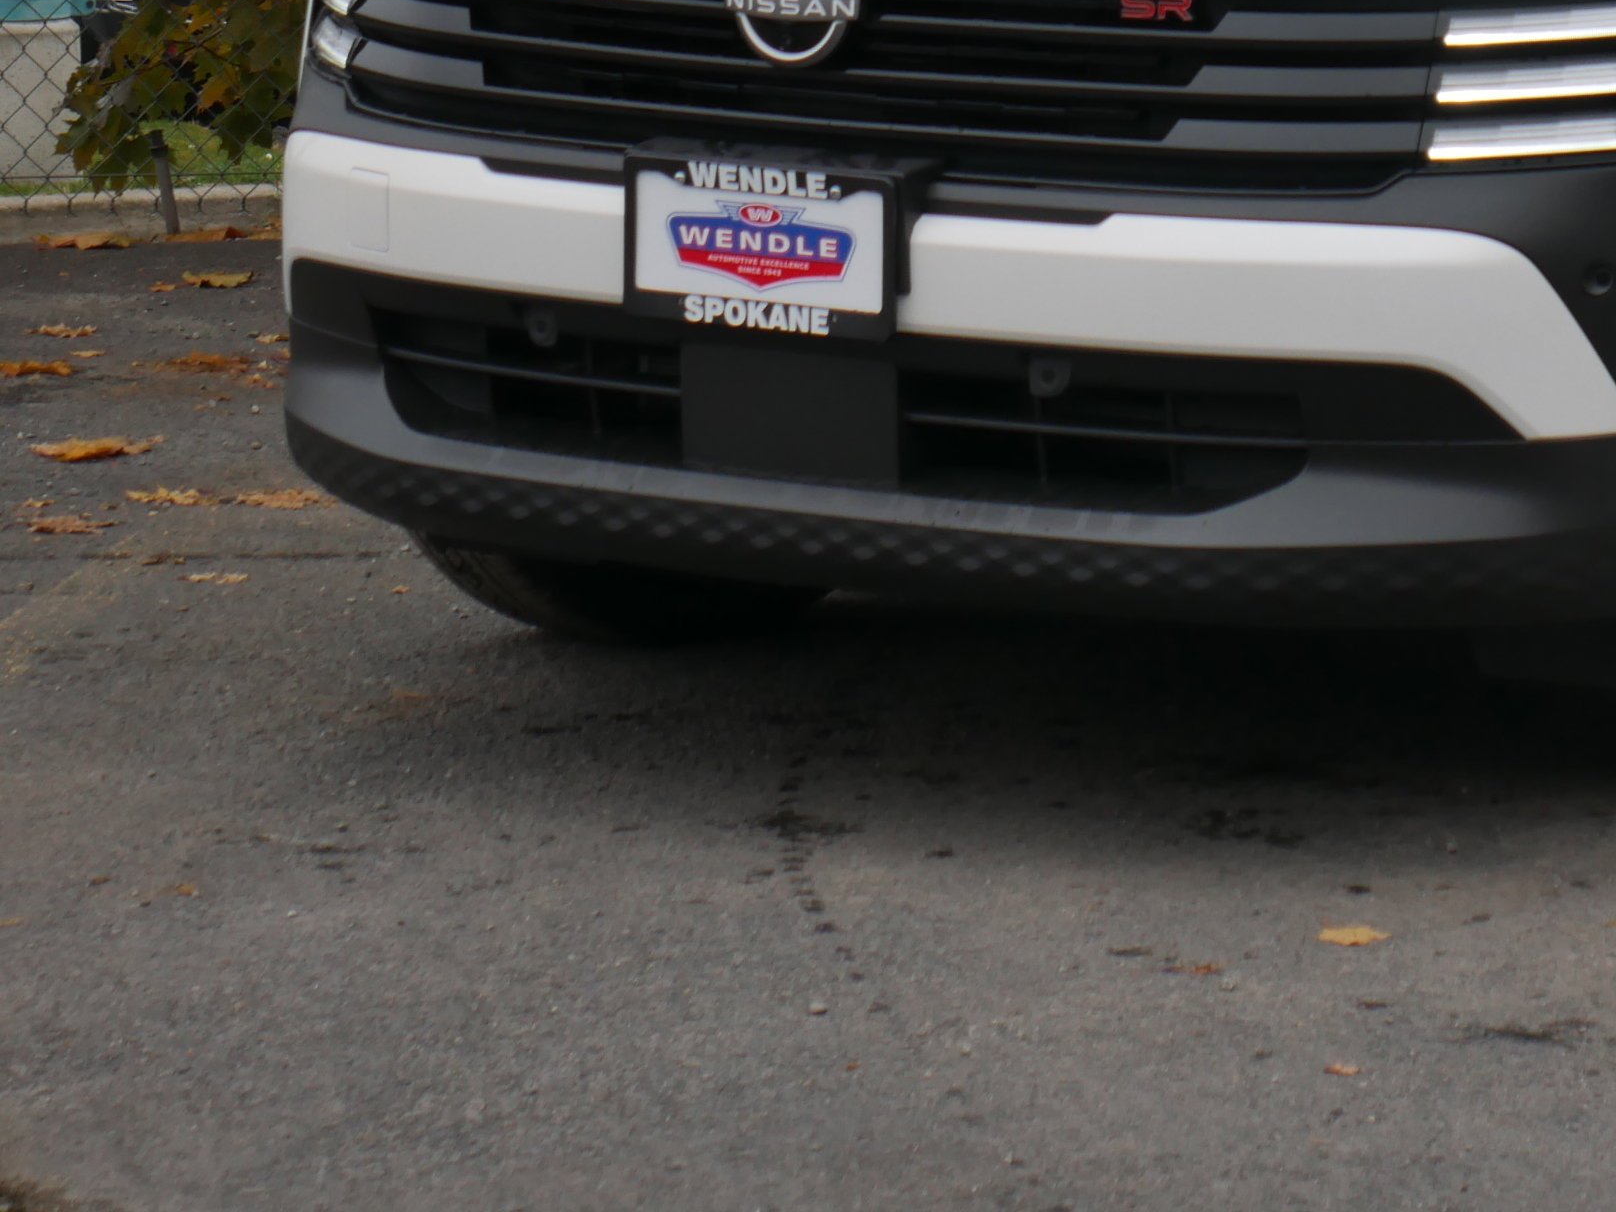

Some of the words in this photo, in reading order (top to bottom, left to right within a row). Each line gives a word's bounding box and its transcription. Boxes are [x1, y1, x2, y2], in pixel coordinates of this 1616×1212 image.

[688, 161, 828, 199] WENDLE
[679, 225, 837, 258] WENDLE
[708, 254, 758, 266] AUTOMOTIVE
[760, 258, 810, 271] EXCELLENCE
[738, 266, 761, 276] SINCE
[684, 295, 829, 335] SPOKANE
